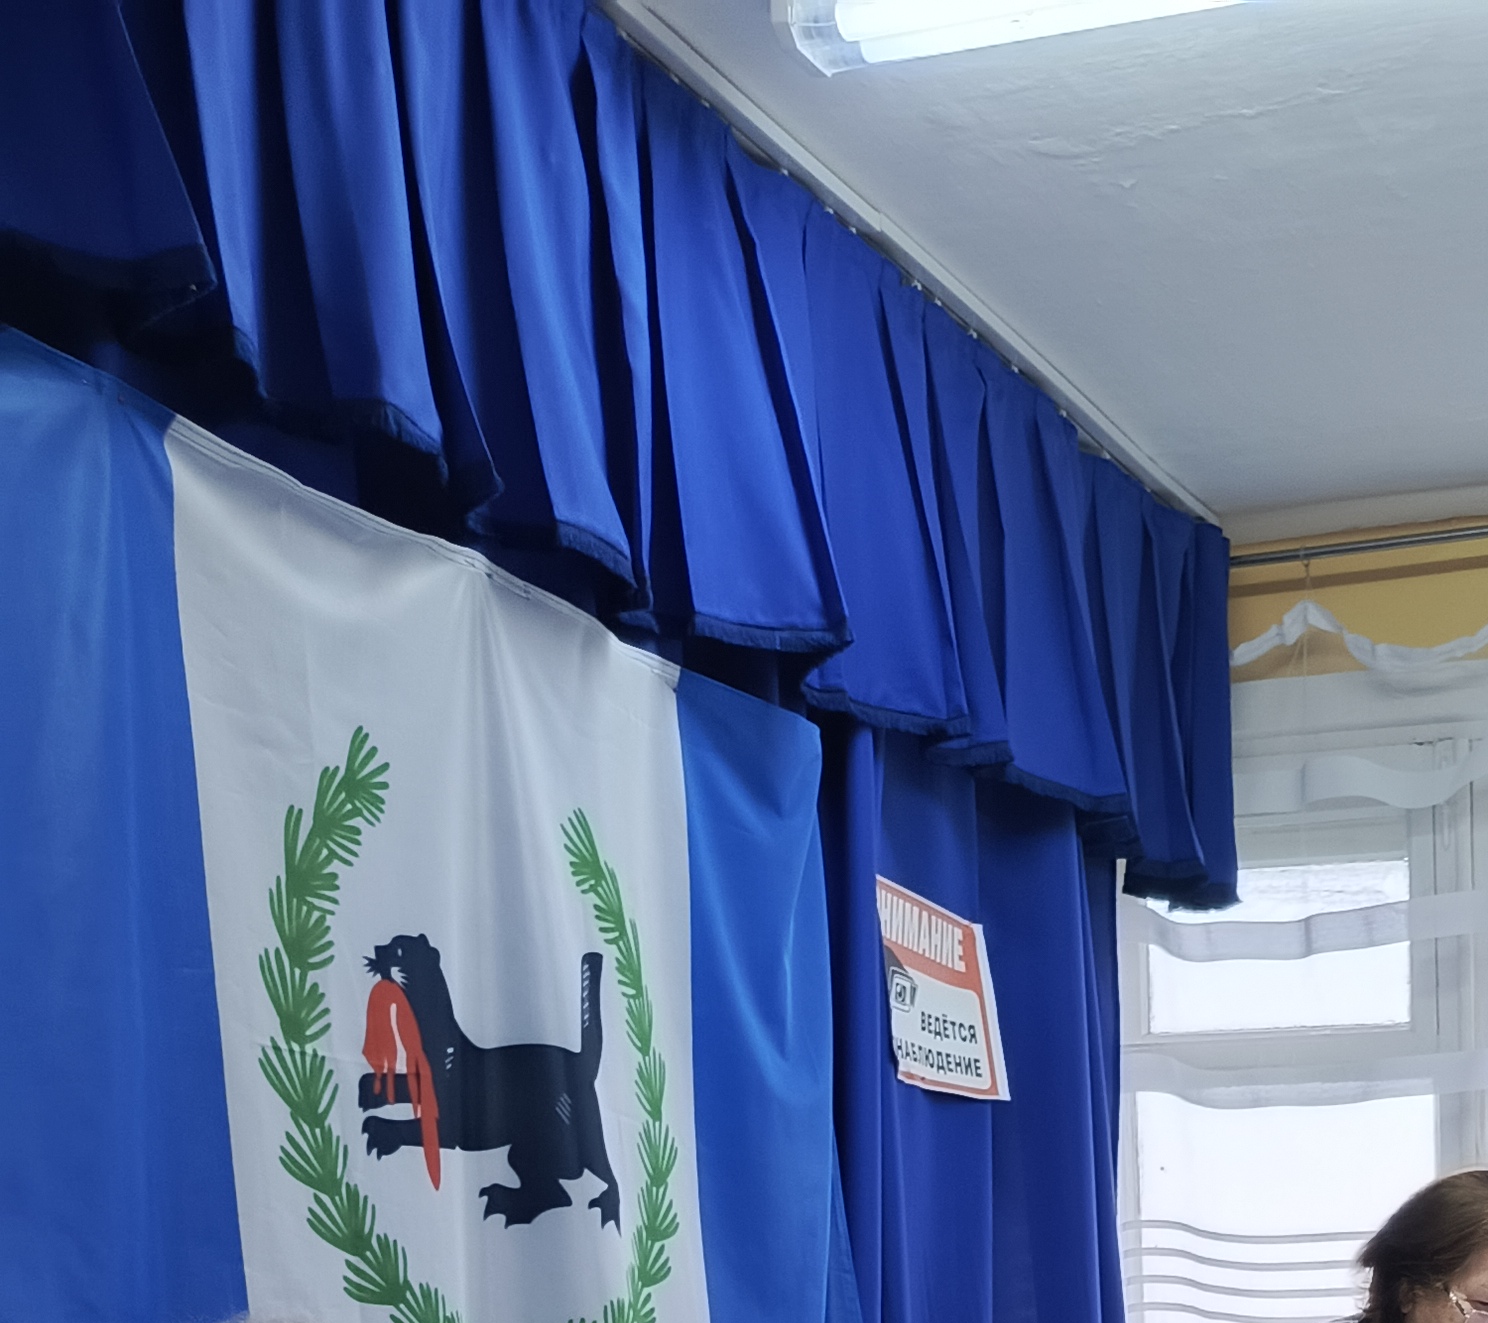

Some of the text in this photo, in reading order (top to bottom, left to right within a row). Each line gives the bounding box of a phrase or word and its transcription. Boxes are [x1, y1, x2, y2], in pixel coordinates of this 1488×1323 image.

[878, 889, 966, 973] НИМАНИЕ
[920, 1010, 978, 1045] ВЕДЁТСЯ
[895, 1039, 982, 1078] НАБЛЮДЕНИЕ
